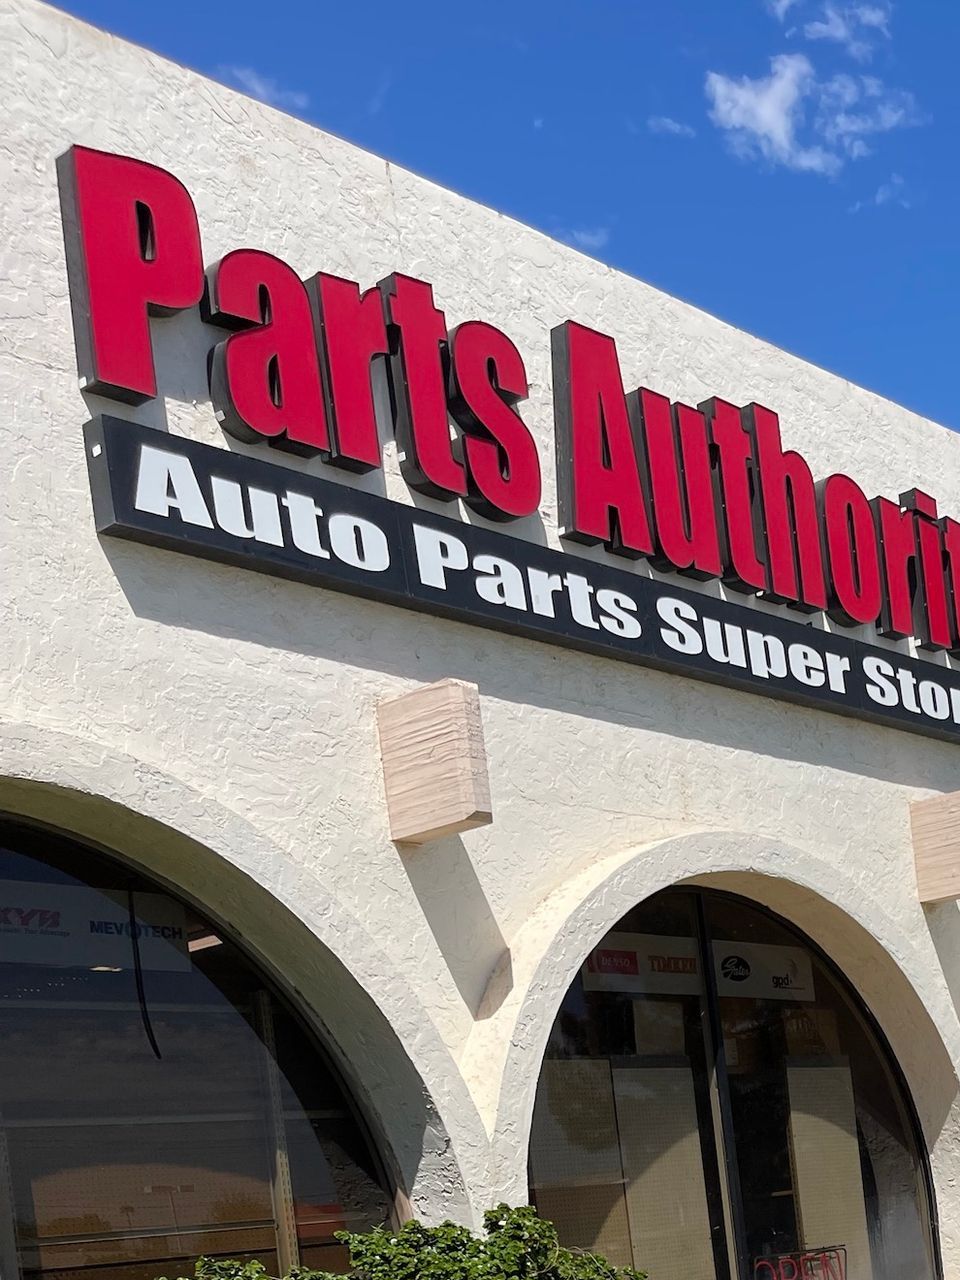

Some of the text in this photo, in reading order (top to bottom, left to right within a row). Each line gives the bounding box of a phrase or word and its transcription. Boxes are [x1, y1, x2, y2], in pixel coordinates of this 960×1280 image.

[57, 145, 541, 522] Parts
[135, 444, 390, 573] Auto
[414, 522, 641, 640] Parts
[658, 596, 850, 695] Super
[89, 920, 182, 940] MEVOTECH
